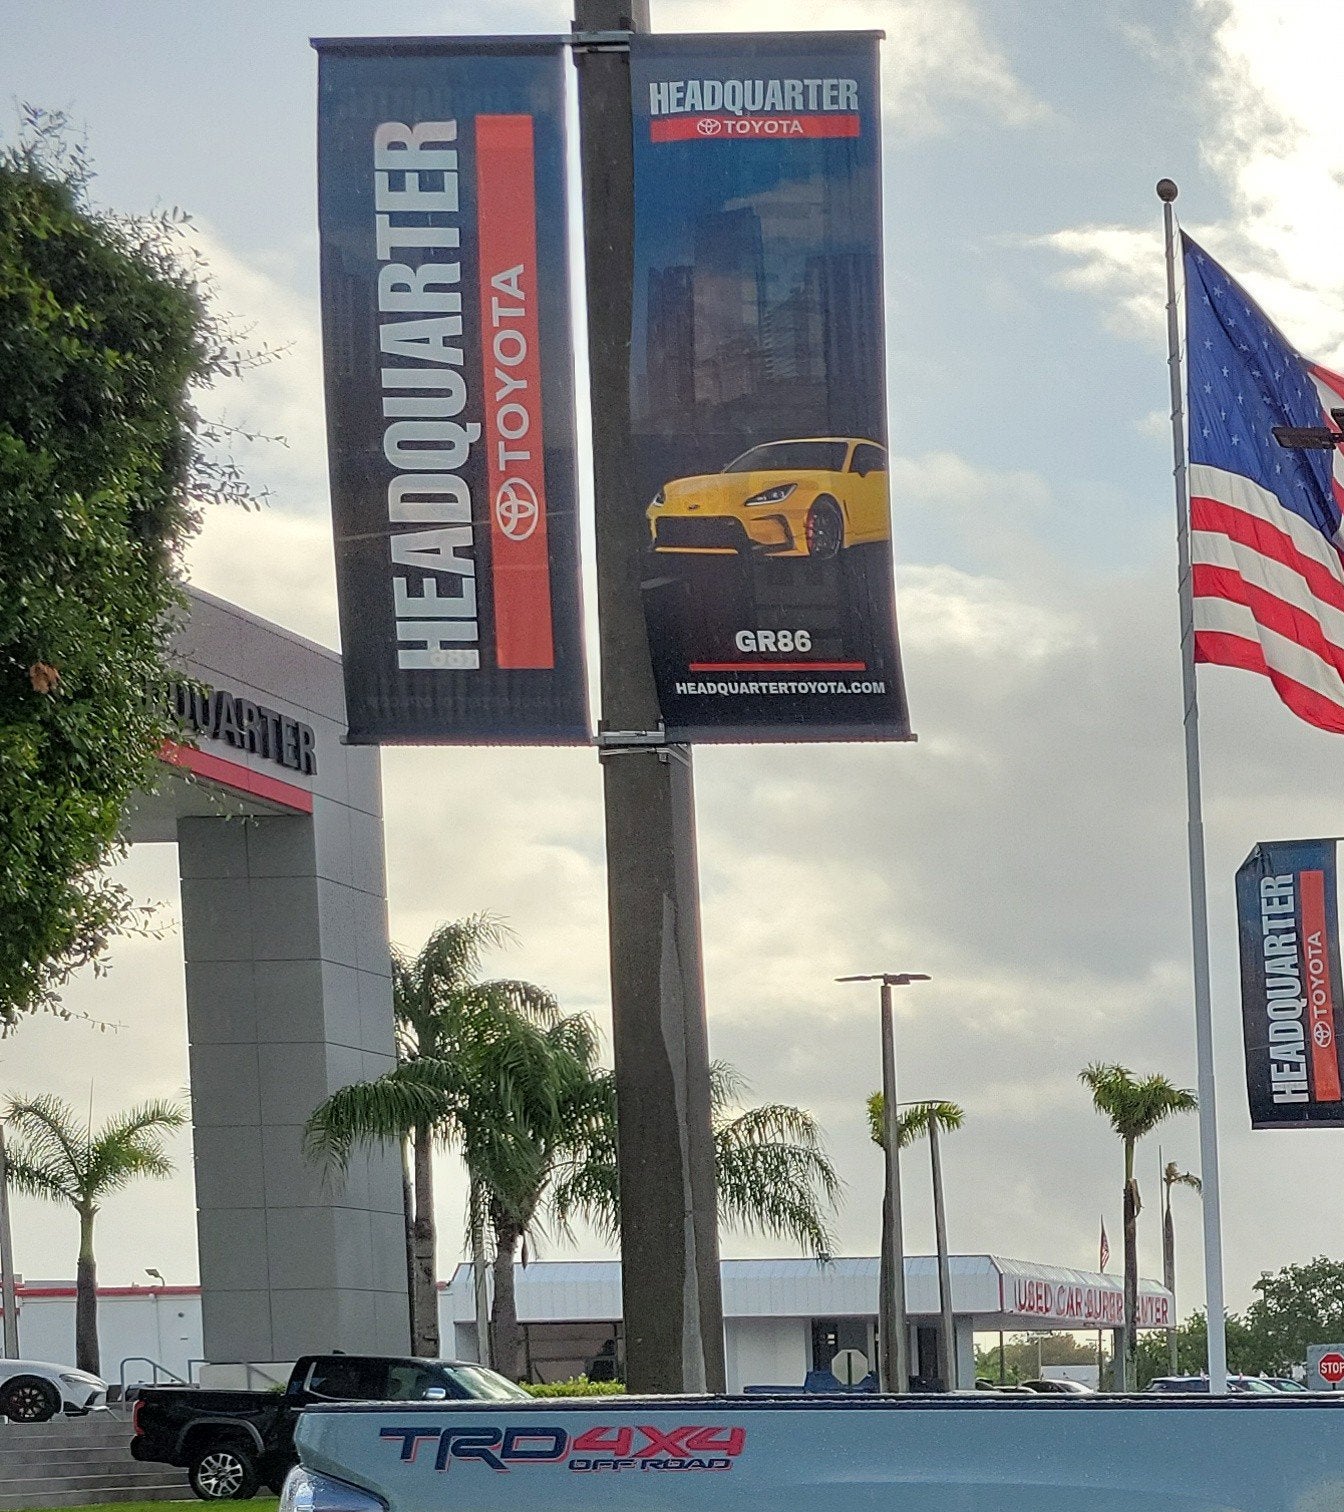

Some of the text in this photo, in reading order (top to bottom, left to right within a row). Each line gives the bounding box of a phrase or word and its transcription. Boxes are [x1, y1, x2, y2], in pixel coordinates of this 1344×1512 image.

[650, 78, 859, 116] HEADQUARTER
[723, 118, 804, 136] TOYOTA
[490, 264, 532, 471] TOYOTA
[374, 119, 481, 670] HEADQUARTER
[735, 629, 812, 655] GR86
[675, 680, 886, 697] HEADQUARTERTOYOTA.COM
[1260, 873, 1309, 1105] HEADQUARTER
[1307, 931, 1328, 1018] TOYOTA
[1014, 1279, 1053, 1313] USED
[1055, 1285, 1083, 1317] CAR
[379, 1425, 746, 1473] TRD 4X4
[567, 1458, 734, 1472] OFF ROAD
